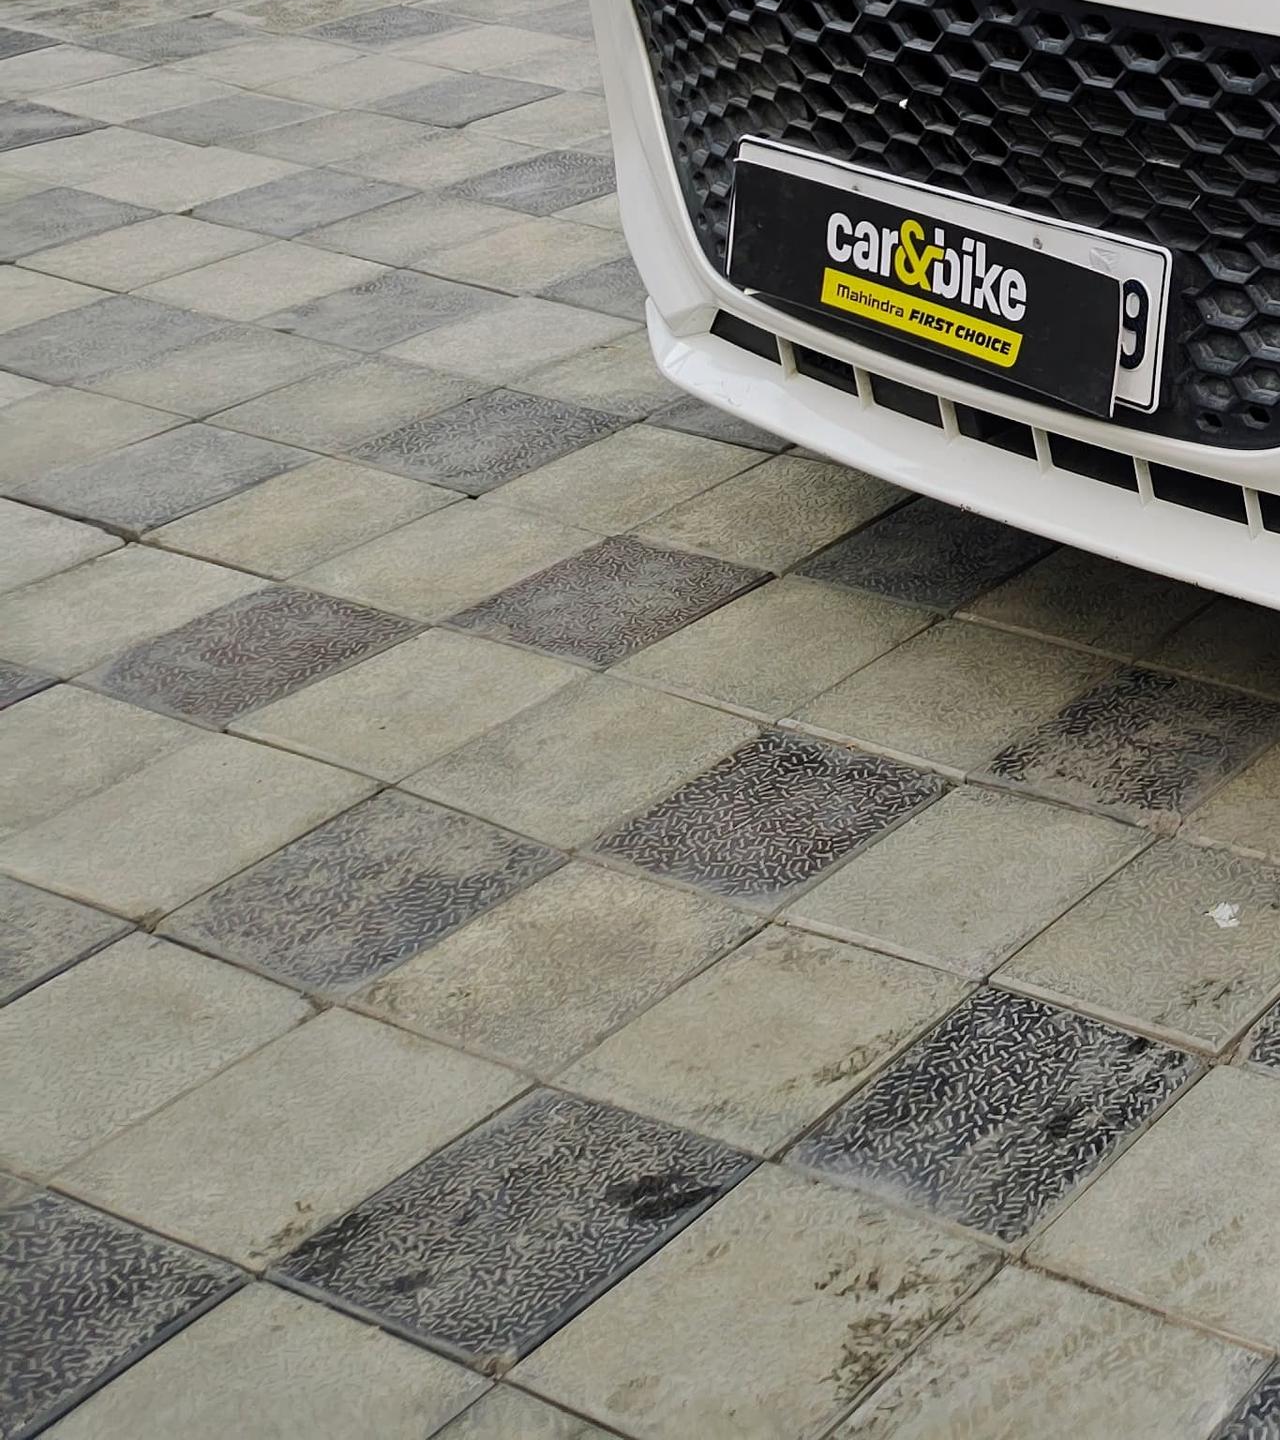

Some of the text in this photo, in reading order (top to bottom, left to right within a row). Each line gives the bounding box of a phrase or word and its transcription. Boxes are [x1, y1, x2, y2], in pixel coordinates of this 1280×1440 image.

[827, 212, 1028, 322] car&bike
[836, 282, 1012, 356] Mahindra FIRST CHOICE
